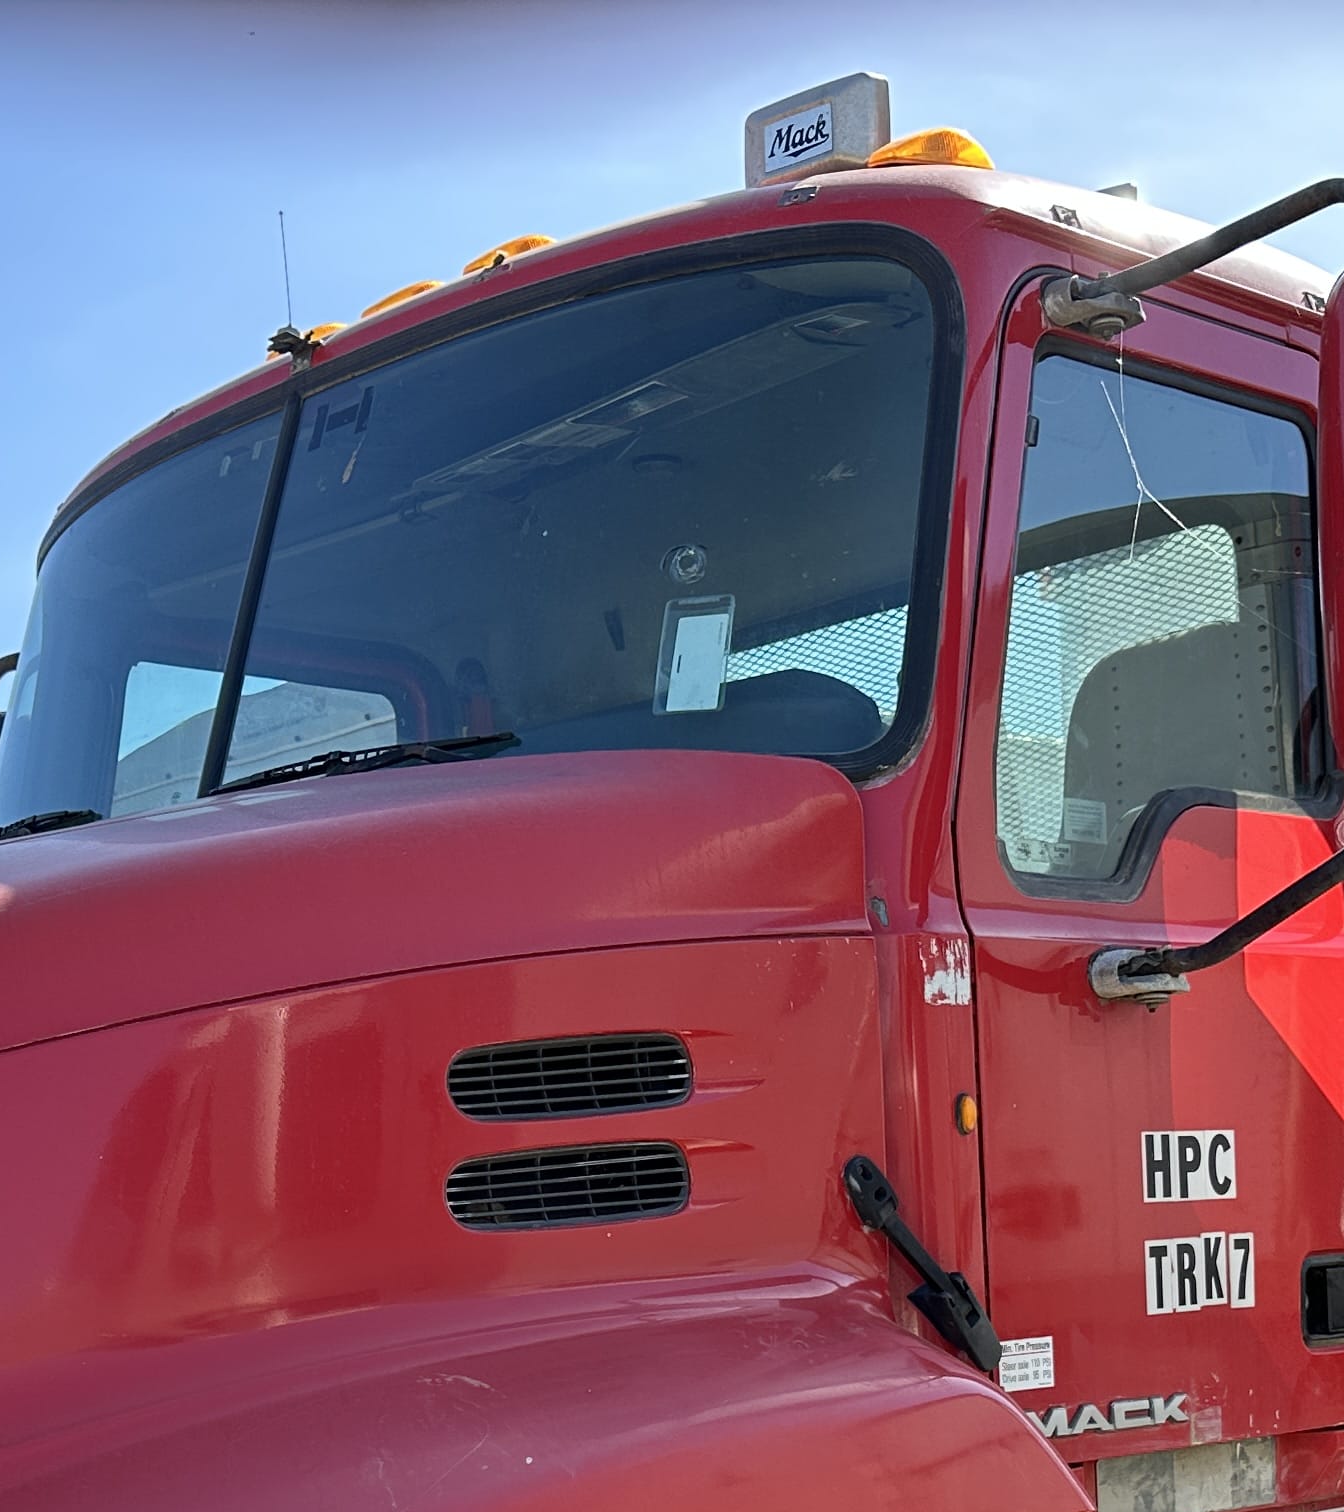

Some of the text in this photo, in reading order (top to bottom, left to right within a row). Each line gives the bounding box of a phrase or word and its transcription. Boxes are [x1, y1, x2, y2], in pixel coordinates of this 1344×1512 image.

[767, 112, 830, 158] Mack
[1144, 1132, 1233, 1199] HPC
[1026, 1341, 1050, 1351] Pressure
